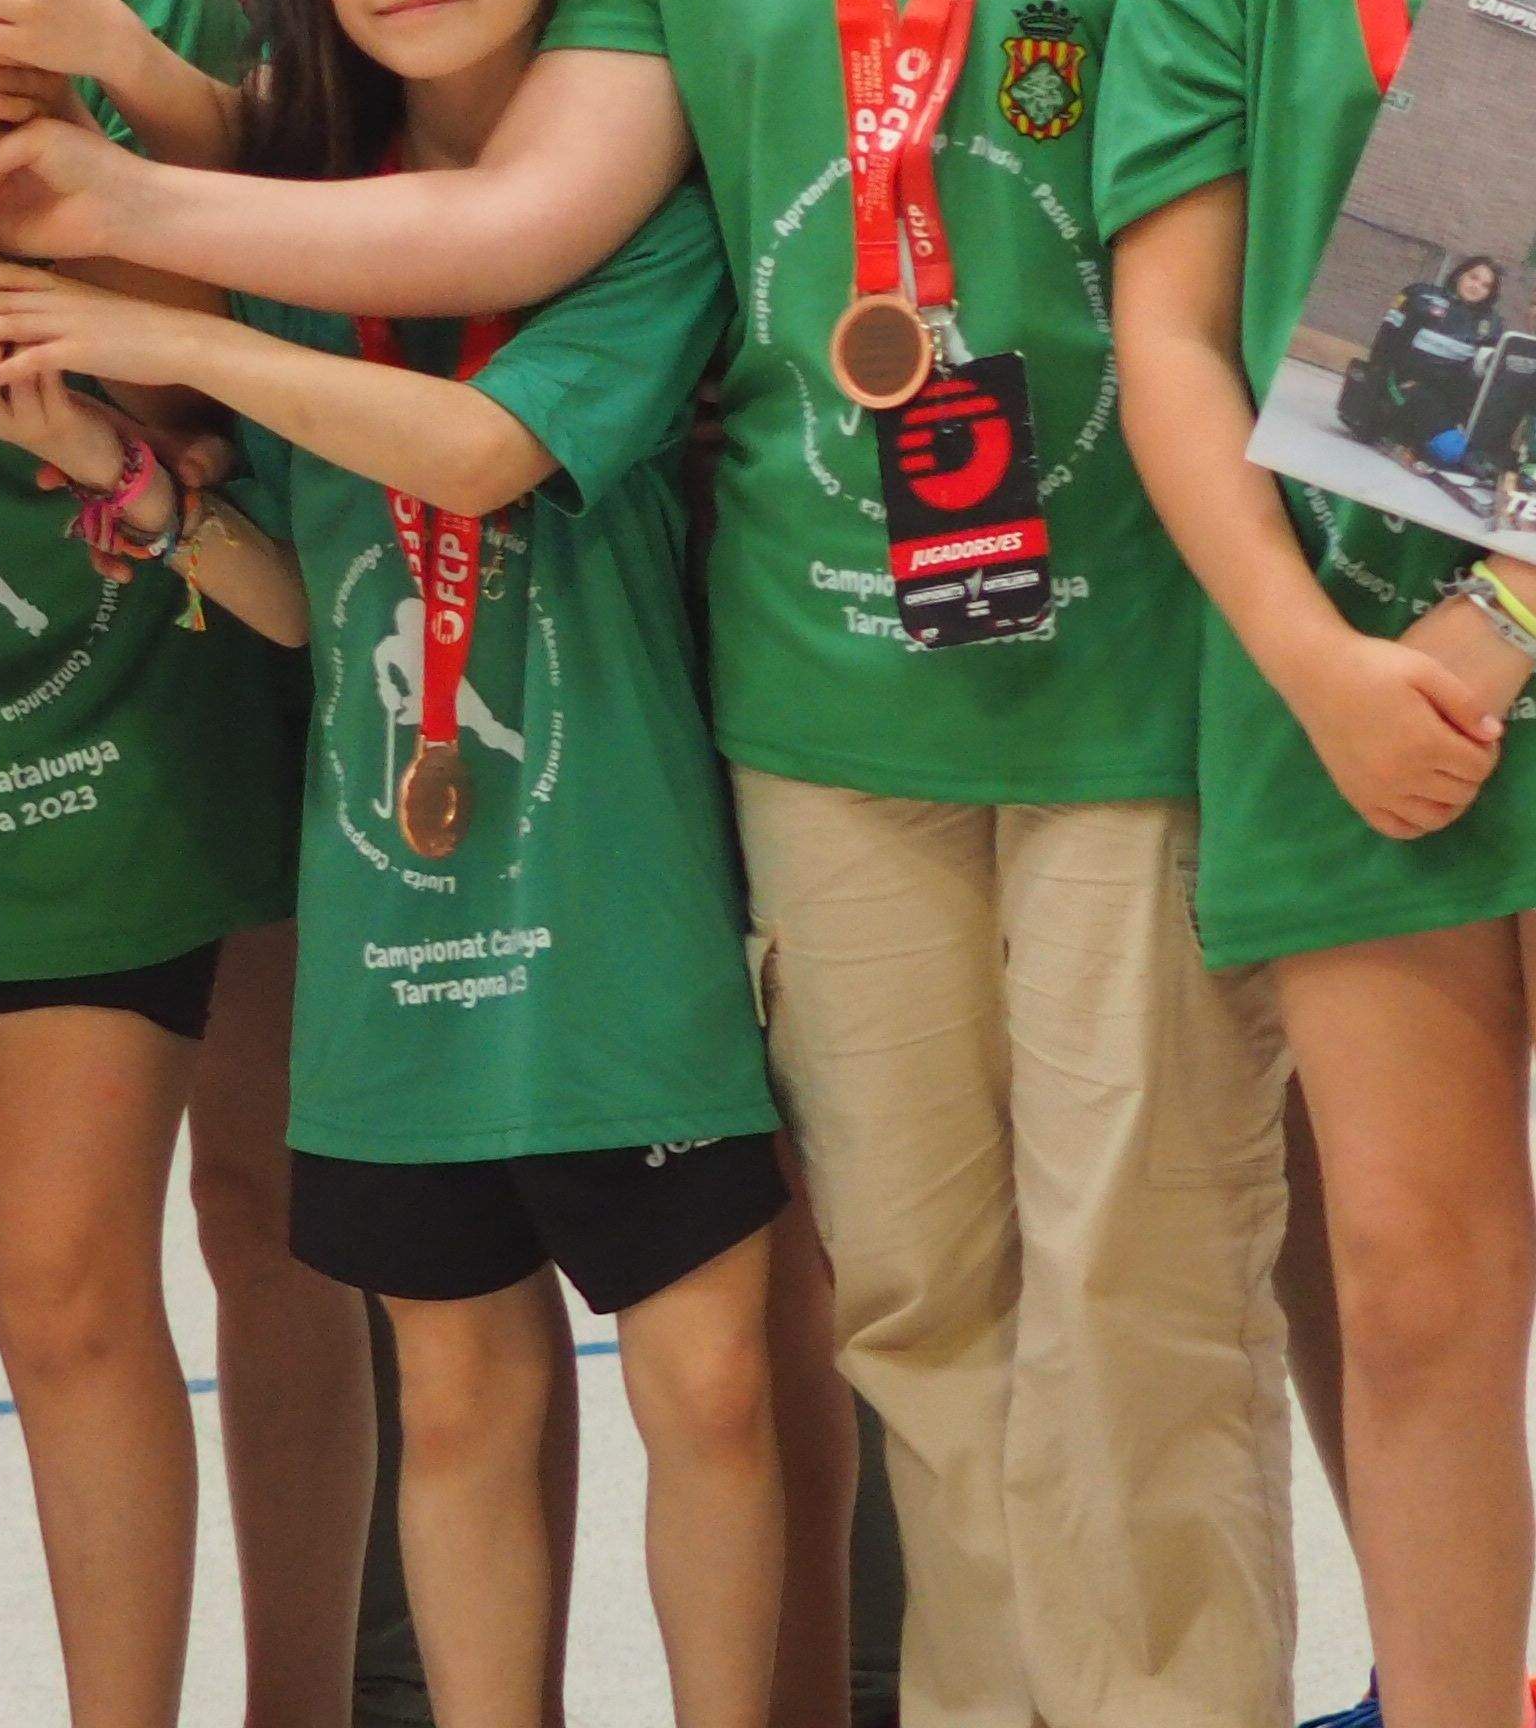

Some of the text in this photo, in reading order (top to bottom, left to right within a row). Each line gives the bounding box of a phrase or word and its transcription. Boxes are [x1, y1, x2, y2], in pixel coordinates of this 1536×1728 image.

[877, 83, 918, 152] FCP
[435, 532, 469, 607] FCP
[910, 531, 1024, 572] JUGADORS/ES
[20, 785, 99, 826] 2023
[364, 933, 486, 973] Campionat
